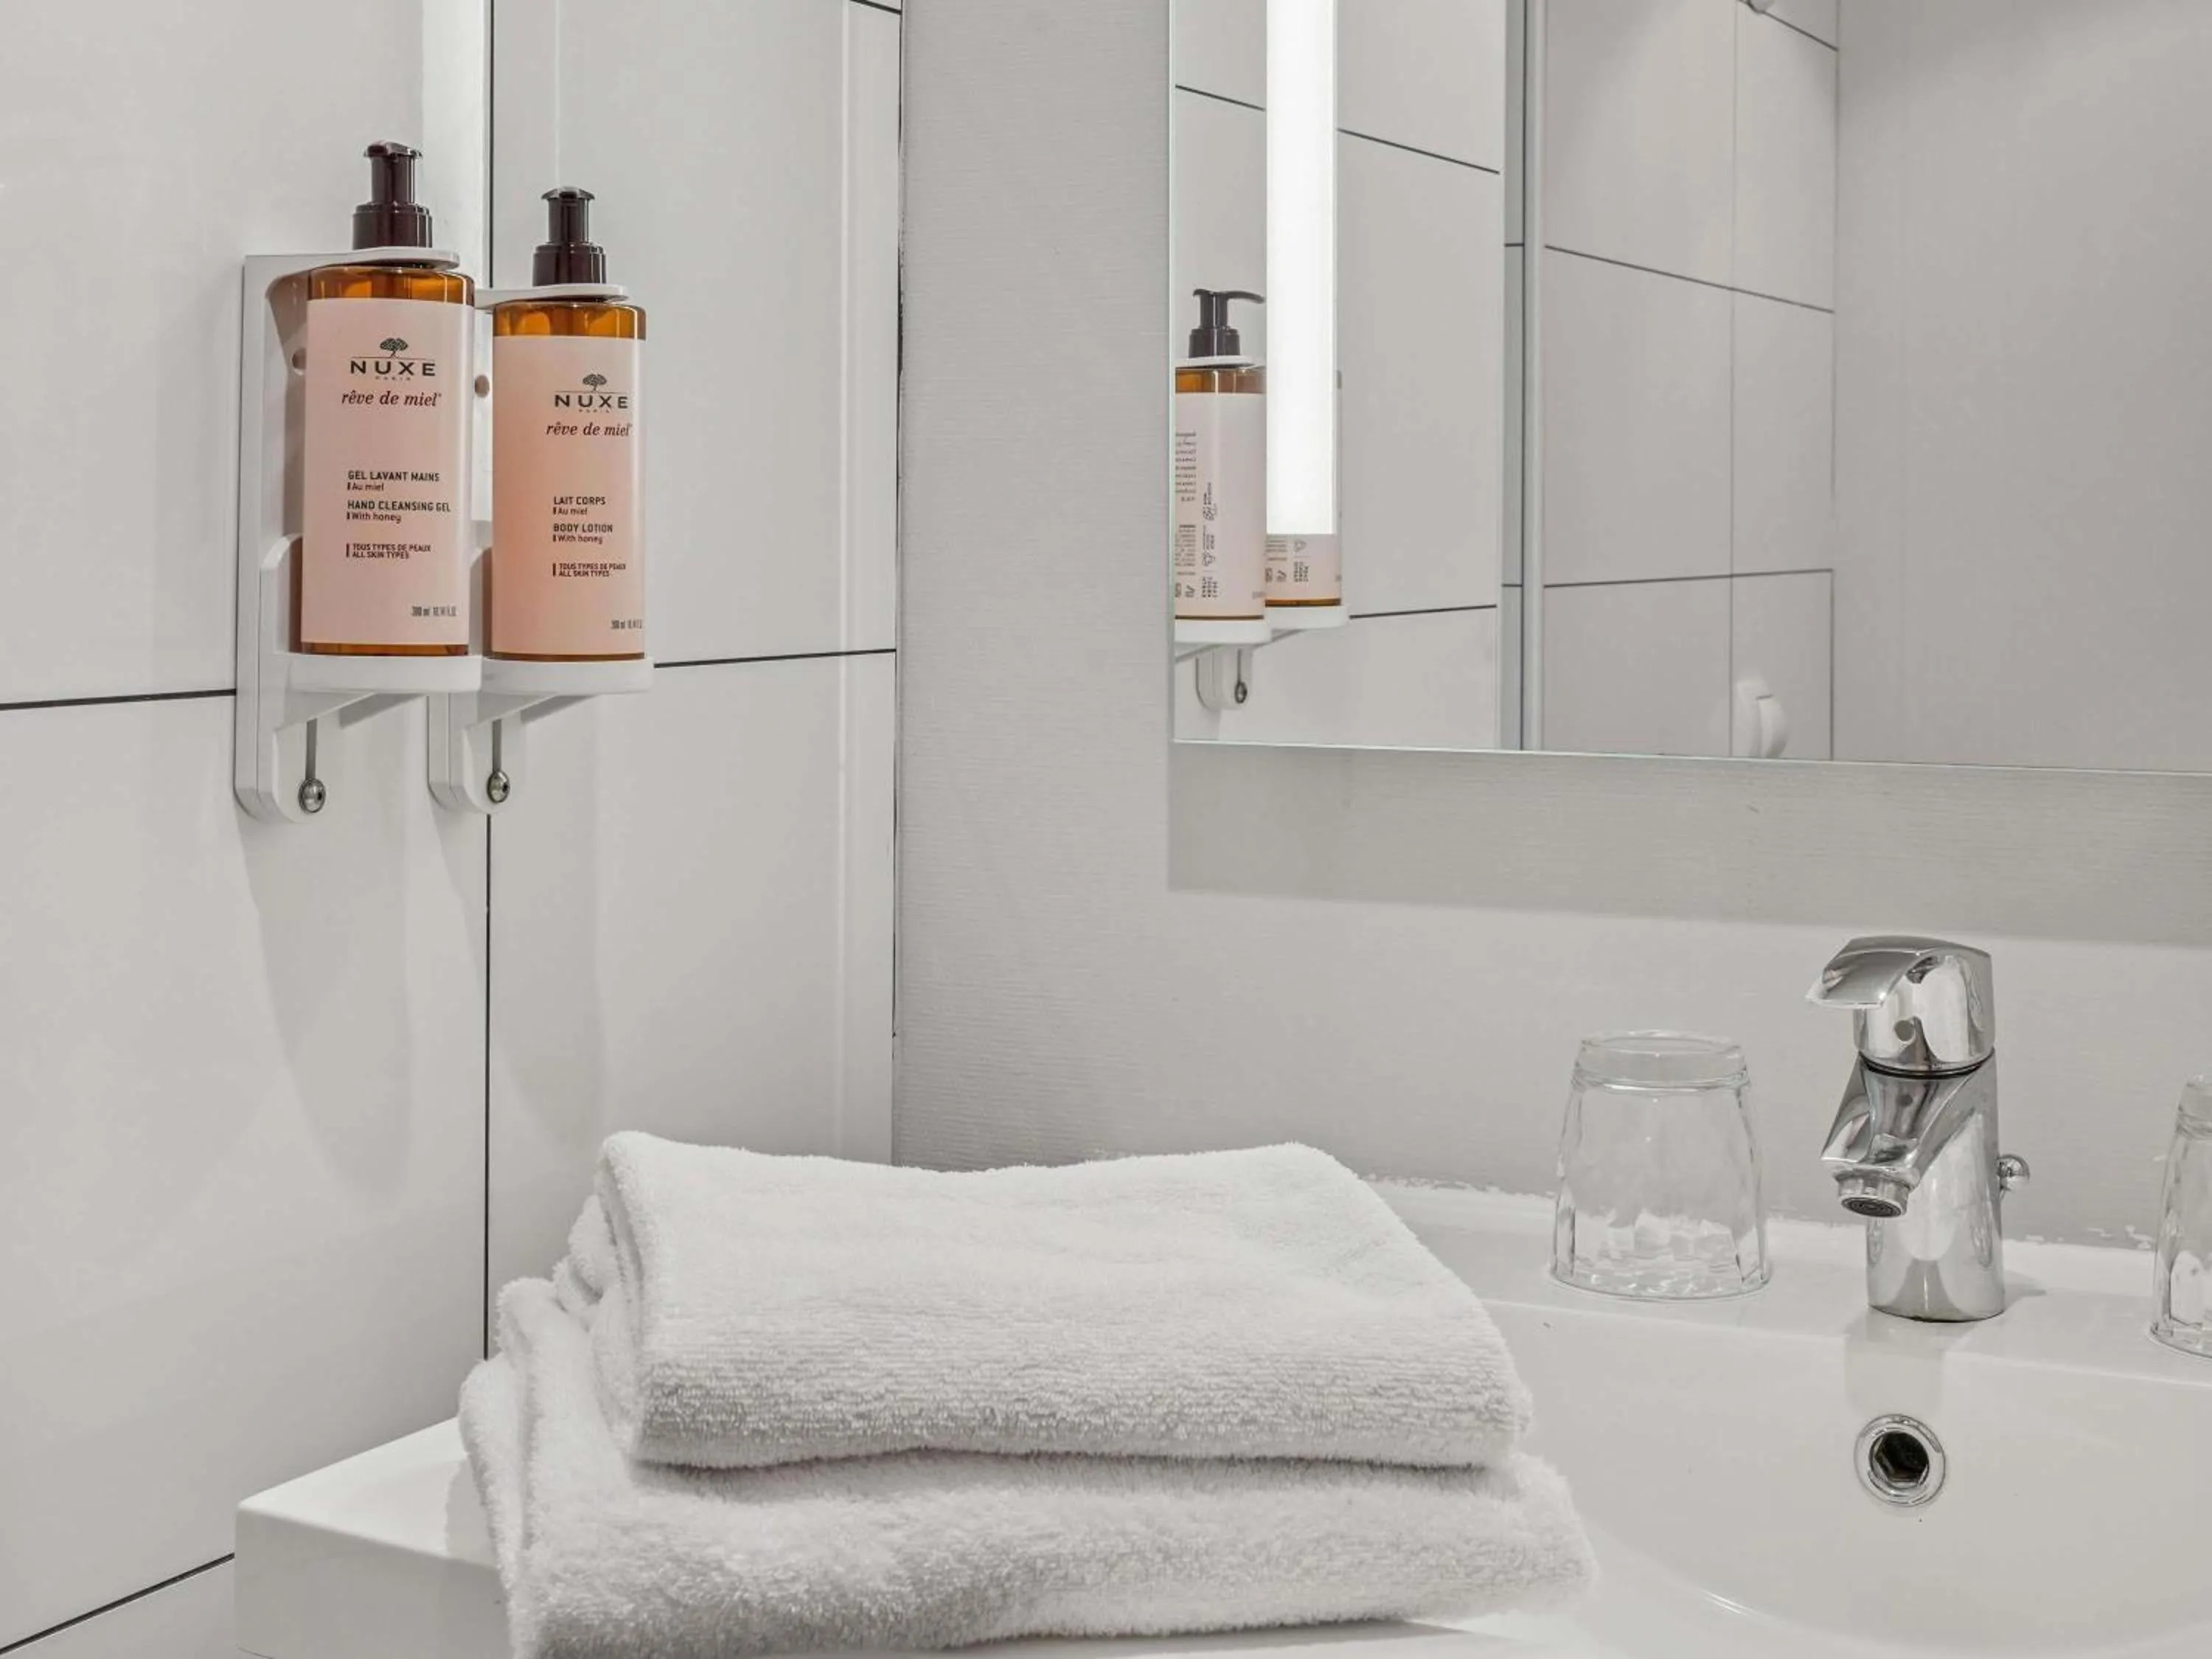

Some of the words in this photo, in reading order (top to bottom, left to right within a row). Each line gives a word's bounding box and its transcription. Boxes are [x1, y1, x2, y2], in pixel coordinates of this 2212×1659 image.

[350, 361, 436, 376] NUXE
[341, 390, 374, 405] rêve
[379, 390, 399, 405] de
[554, 394, 628, 409] NUXE
[546, 421, 577, 436] rêve
[583, 422, 601, 436] de
[347, 470, 367, 480] GEL
[369, 471, 408, 481] LAVANT
[411, 472, 440, 481] MAINS
[352, 482, 363, 490] Au
[365, 483, 384, 491] miel
[347, 500, 375, 509] HAND
[378, 501, 434, 511] CLEANSING
[436, 502, 451, 512] GEL
[554, 496, 574, 505] LAIT
[576, 497, 606, 505] CORPS
[352, 512, 370, 520] With
[372, 512, 402, 524] honey
[554, 524, 579, 532] BODY
[582, 524, 613, 533] LOTION
[578, 535, 603, 545] honey
